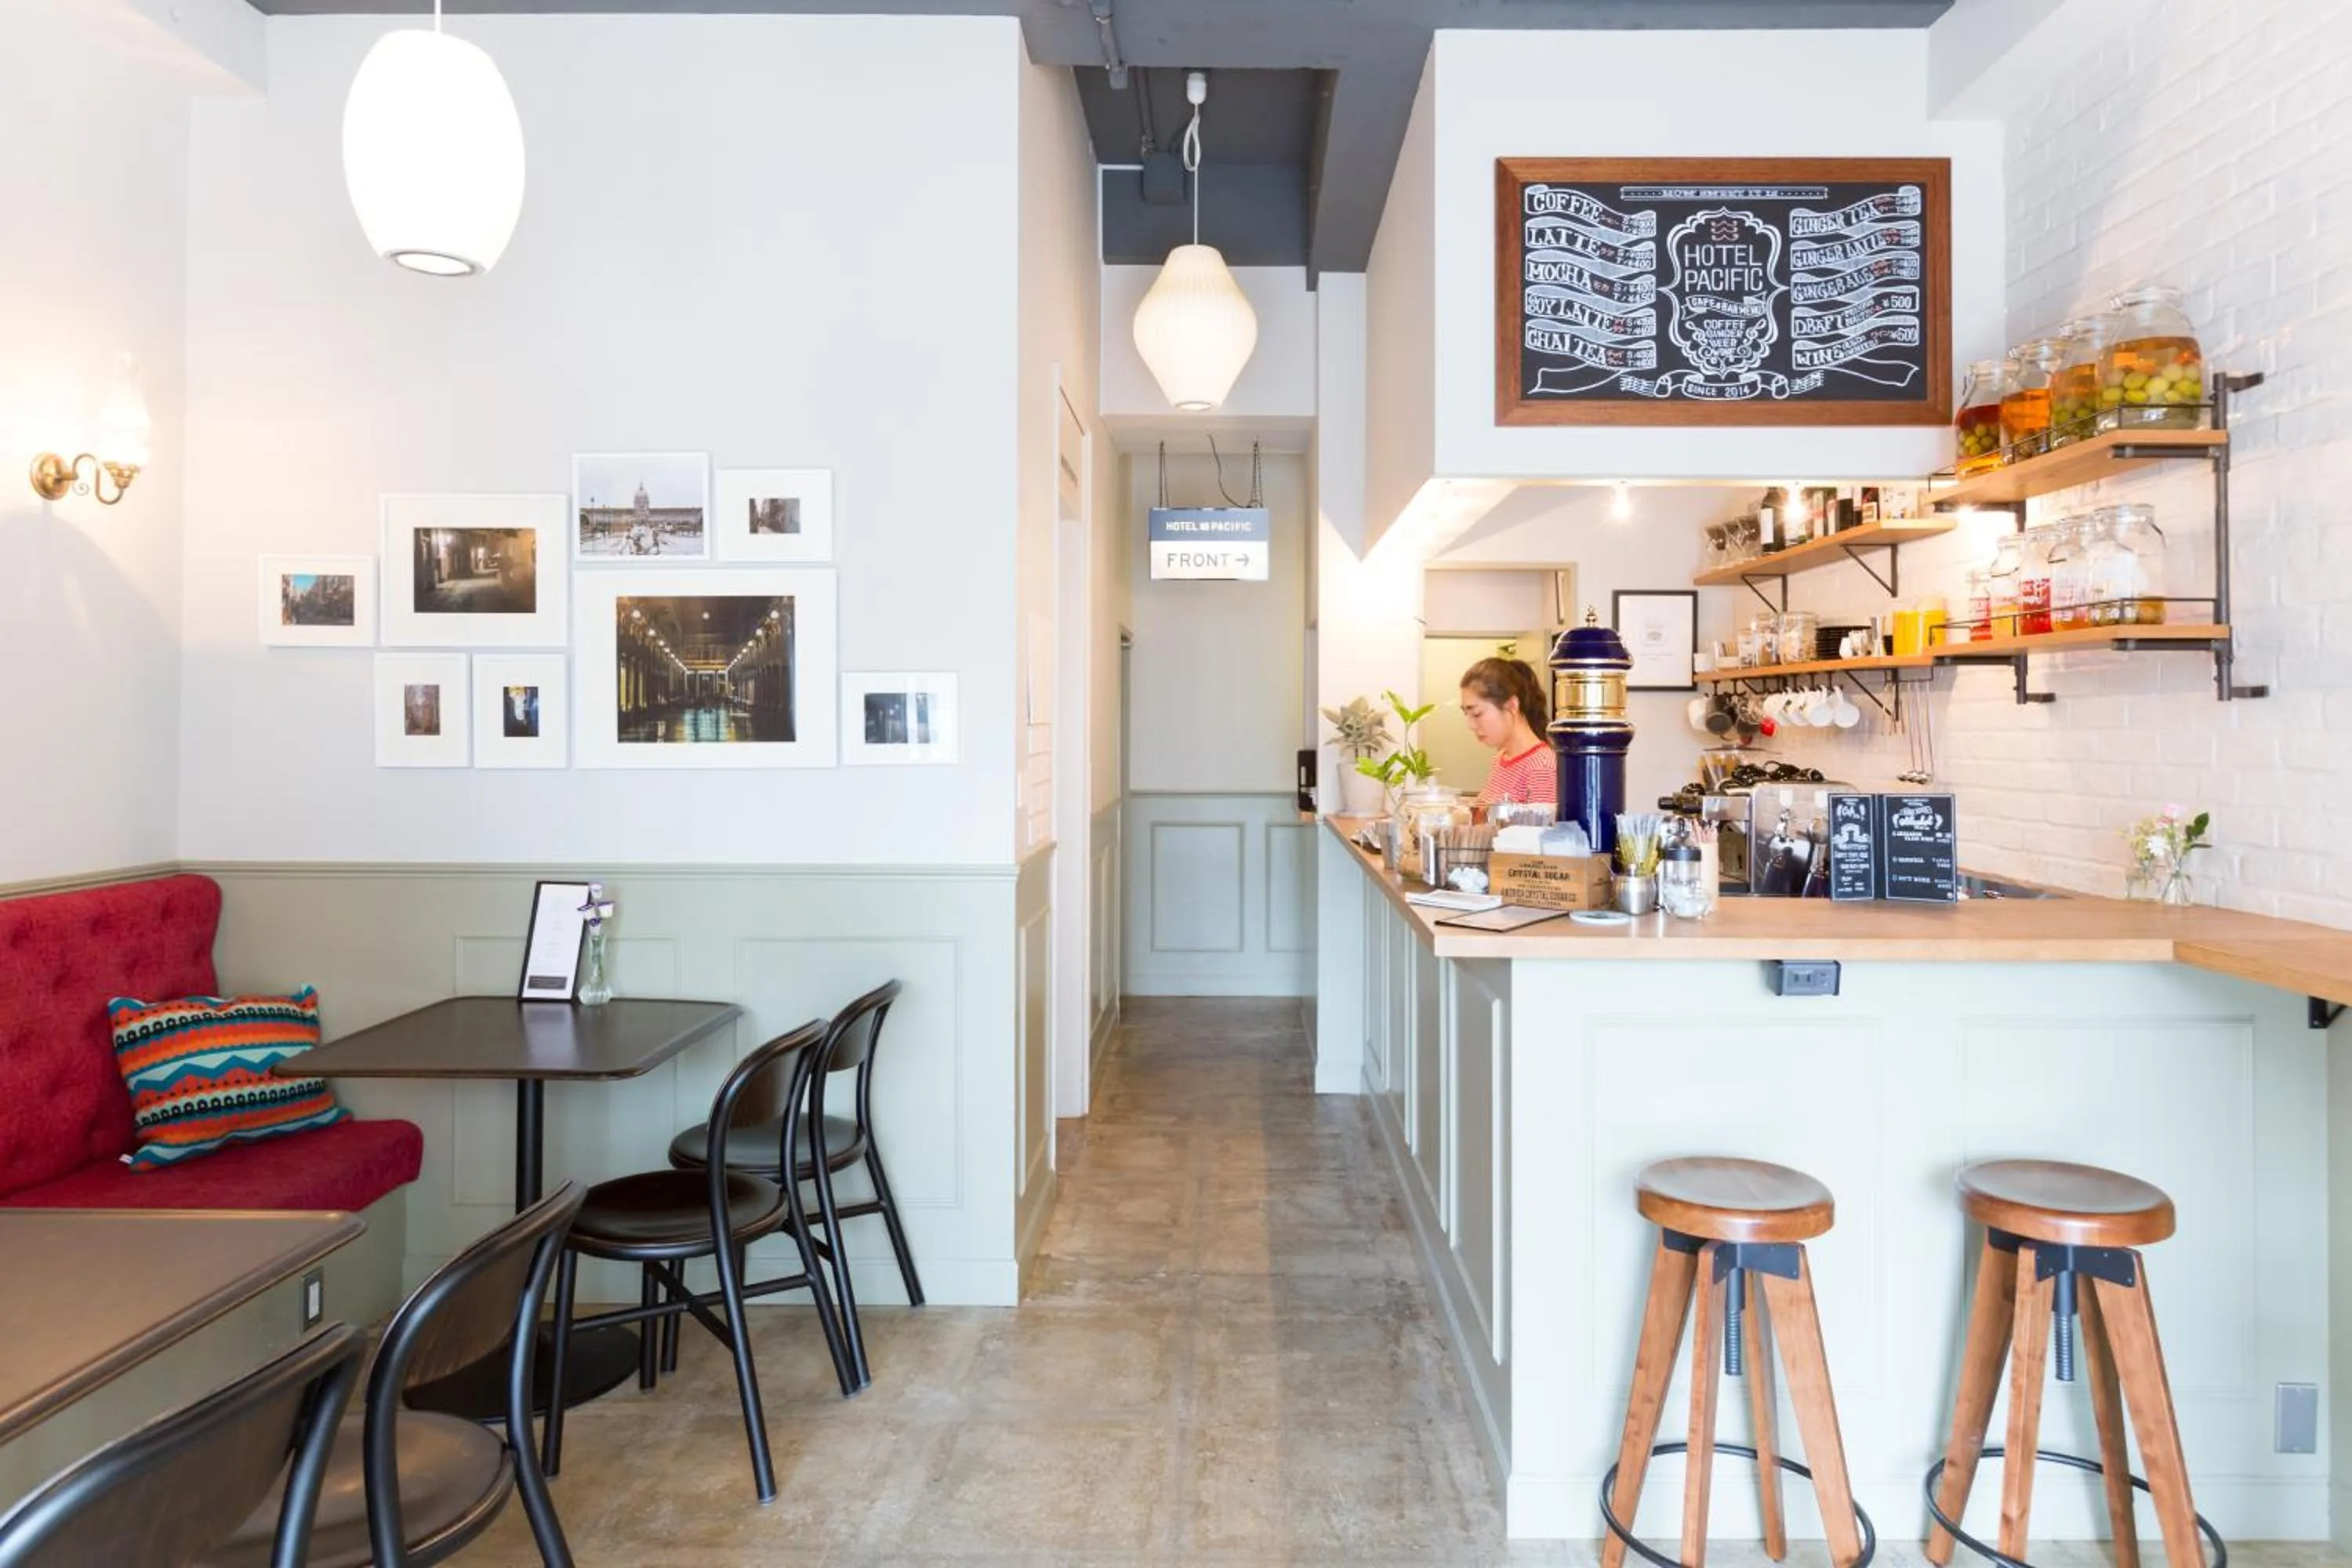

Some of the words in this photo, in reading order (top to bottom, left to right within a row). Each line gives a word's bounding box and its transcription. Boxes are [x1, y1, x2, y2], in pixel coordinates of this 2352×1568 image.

[1534, 192, 1602, 223] COFFEE
[1793, 212, 1847, 234] GINGER
[1846, 201, 1882, 223] TEA
[1529, 228, 1601, 256] LATTE
[1685, 245, 1762, 267] HOTEL
[1793, 245, 1844, 267] GINGER
[1529, 263, 1592, 291] MOCHA
[1685, 268, 1763, 292] PACIFIC
[1794, 278, 1846, 301] GINGER
[1529, 293, 1558, 314] SOY
[1559, 298, 1614, 332] LATTE
[1691, 297, 1716, 309] CAFE
[1704, 319, 1748, 329] COFFEE
[1795, 314, 1844, 335] DRAFT
[1529, 329, 1571, 351] CHAI
[1573, 338, 1607, 365] TEA
[1796, 345, 1844, 365] WINE
[1687, 383, 1717, 396] SINCE
[1724, 385, 1750, 397] 2014
[1166, 521, 1199, 532] HOTEL
[1211, 521, 1252, 532] PACIFIC
[1167, 553, 1230, 568] FRONT
[1508, 869, 1541, 879] CRYSTAL
[1544, 870, 1570, 880] SUGAR
